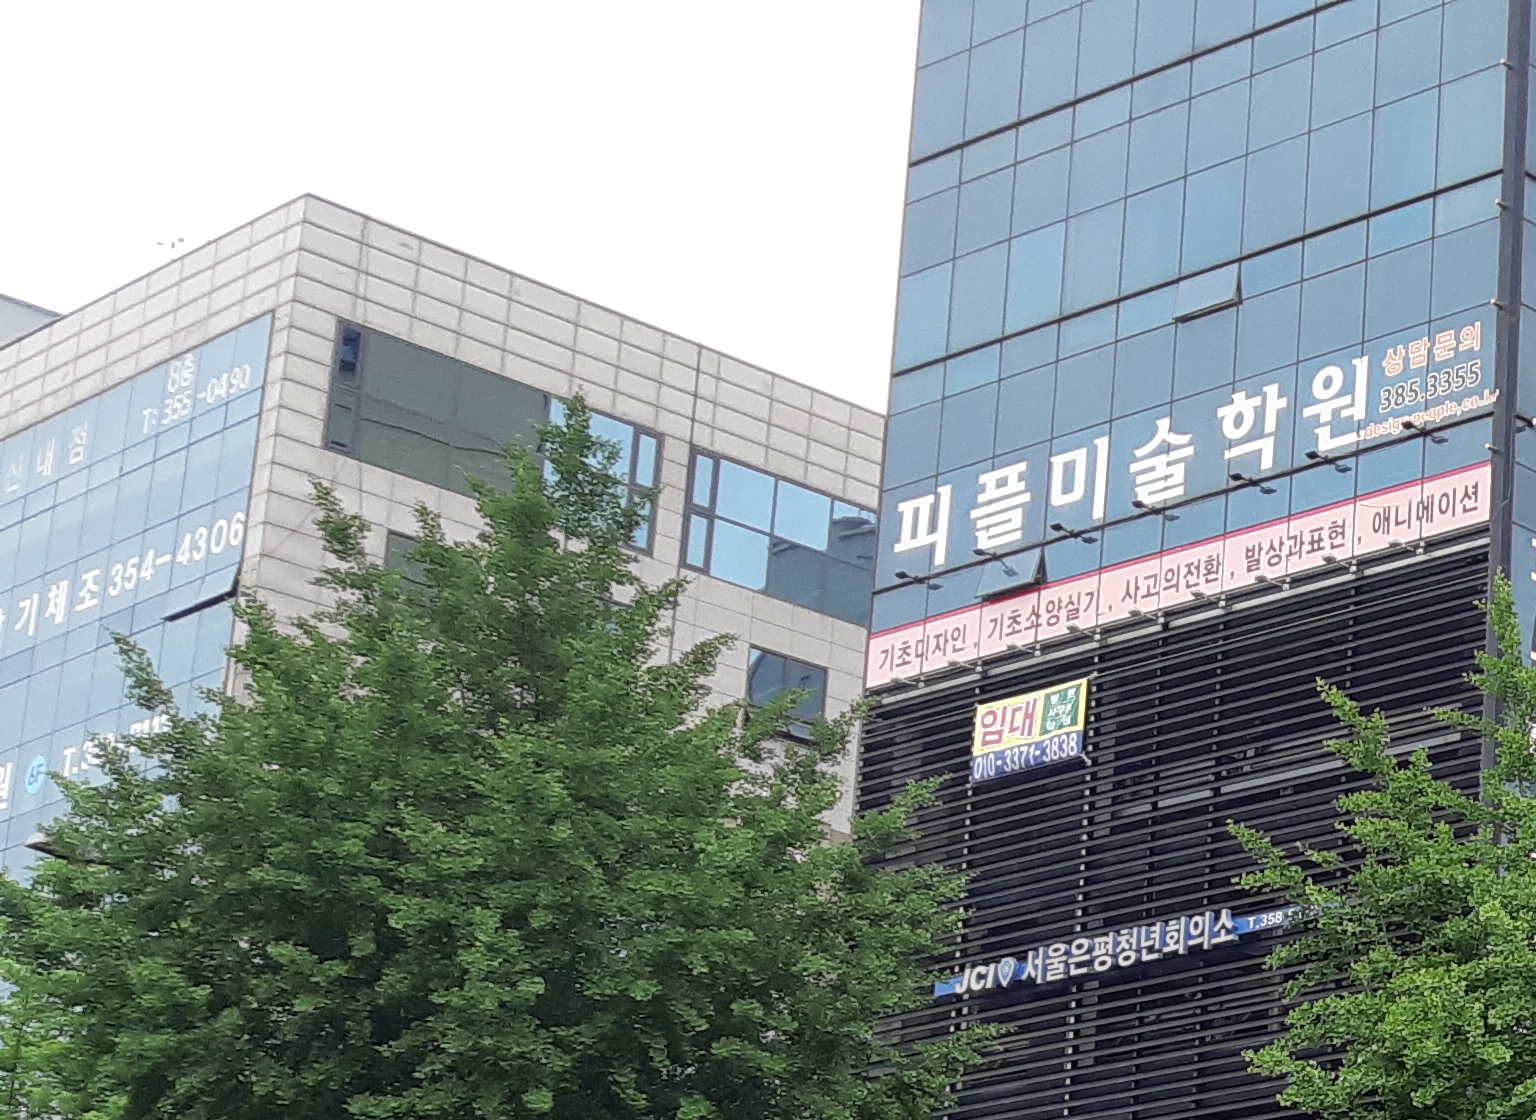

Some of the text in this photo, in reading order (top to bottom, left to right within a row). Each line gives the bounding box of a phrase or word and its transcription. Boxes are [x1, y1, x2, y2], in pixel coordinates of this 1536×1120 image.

[1381, 320, 1482, 377] 상담문의
[1378, 358, 1482, 414] 385.3355
[893, 355, 1371, 567] 피플미술학원
[1371, 480, 1481, 537] 애니메이션
[108, 511, 245, 597] 354-4306
[980, 696, 1039, 748] 임대
[973, 732, 1078, 780] 010-3371-3838
[955, 964, 997, 994] JCI
[1021, 907, 1239, 984] 서울은평청년회의소
